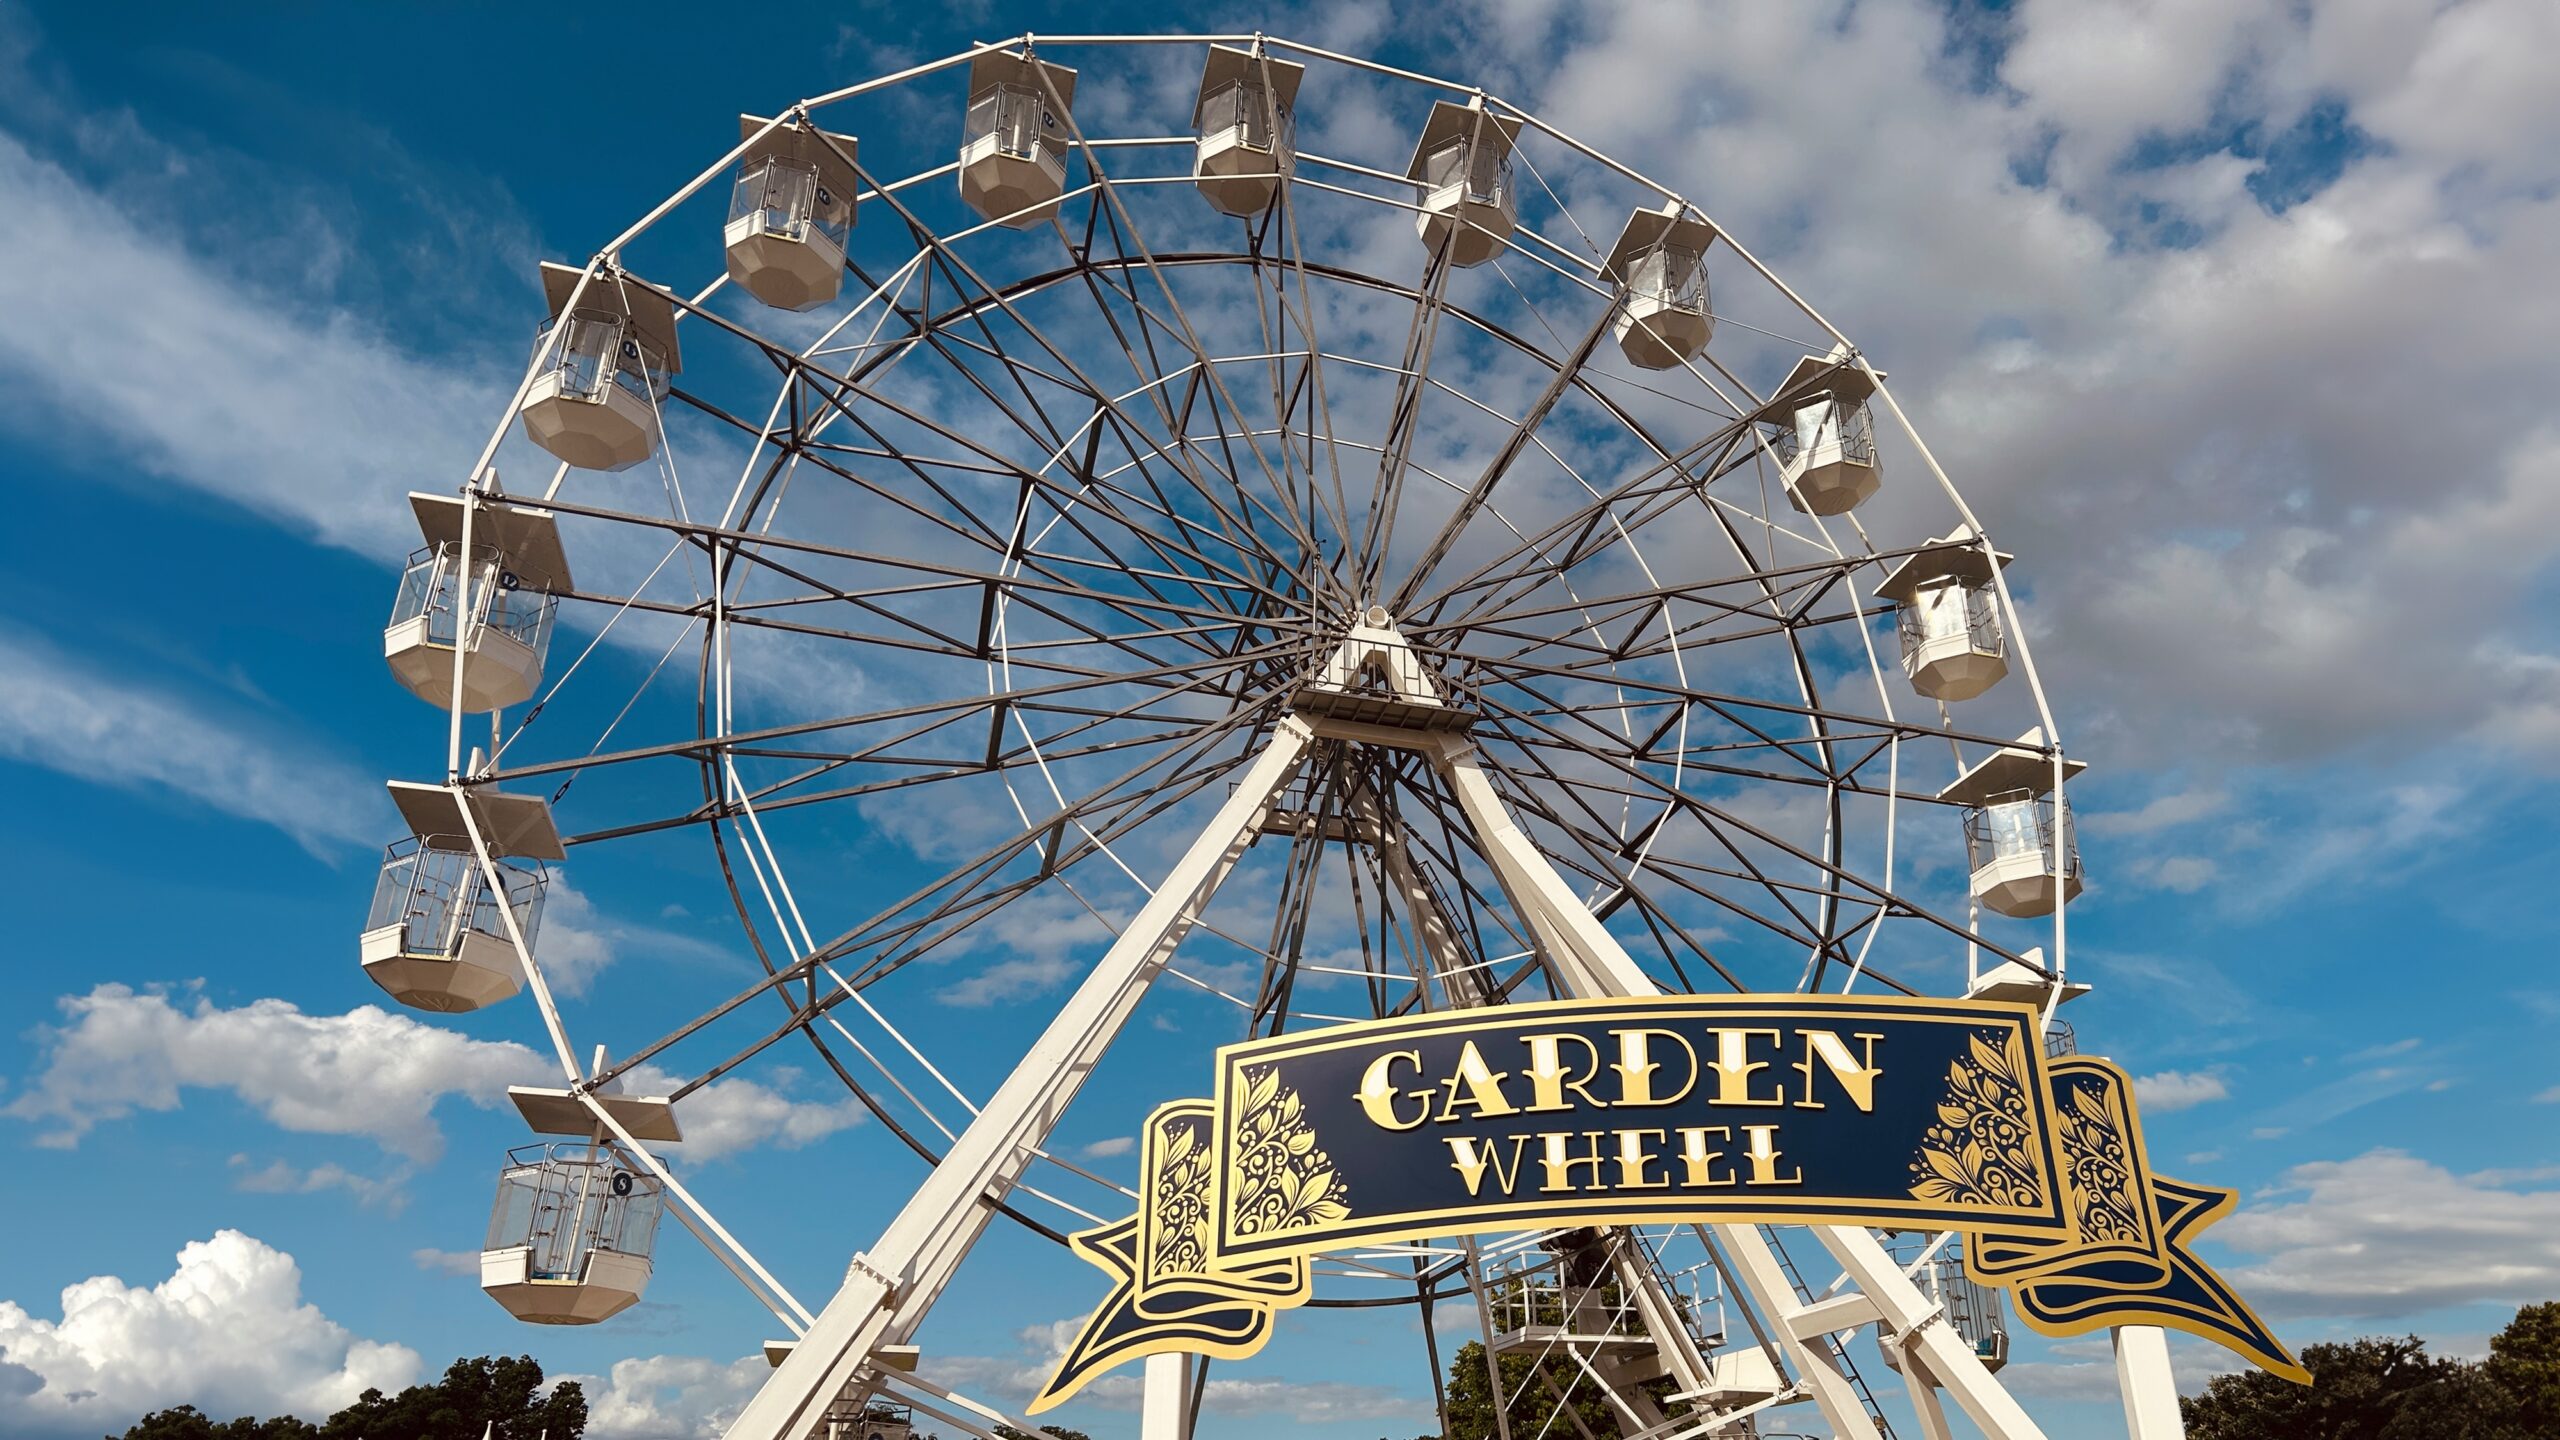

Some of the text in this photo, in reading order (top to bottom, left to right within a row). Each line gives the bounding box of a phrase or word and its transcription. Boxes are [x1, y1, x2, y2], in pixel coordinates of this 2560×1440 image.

[1352, 1027, 1885, 1131] GARDEN
[617, 1178, 628, 1190] 8
[1442, 1125, 1802, 1196] WHEEL
